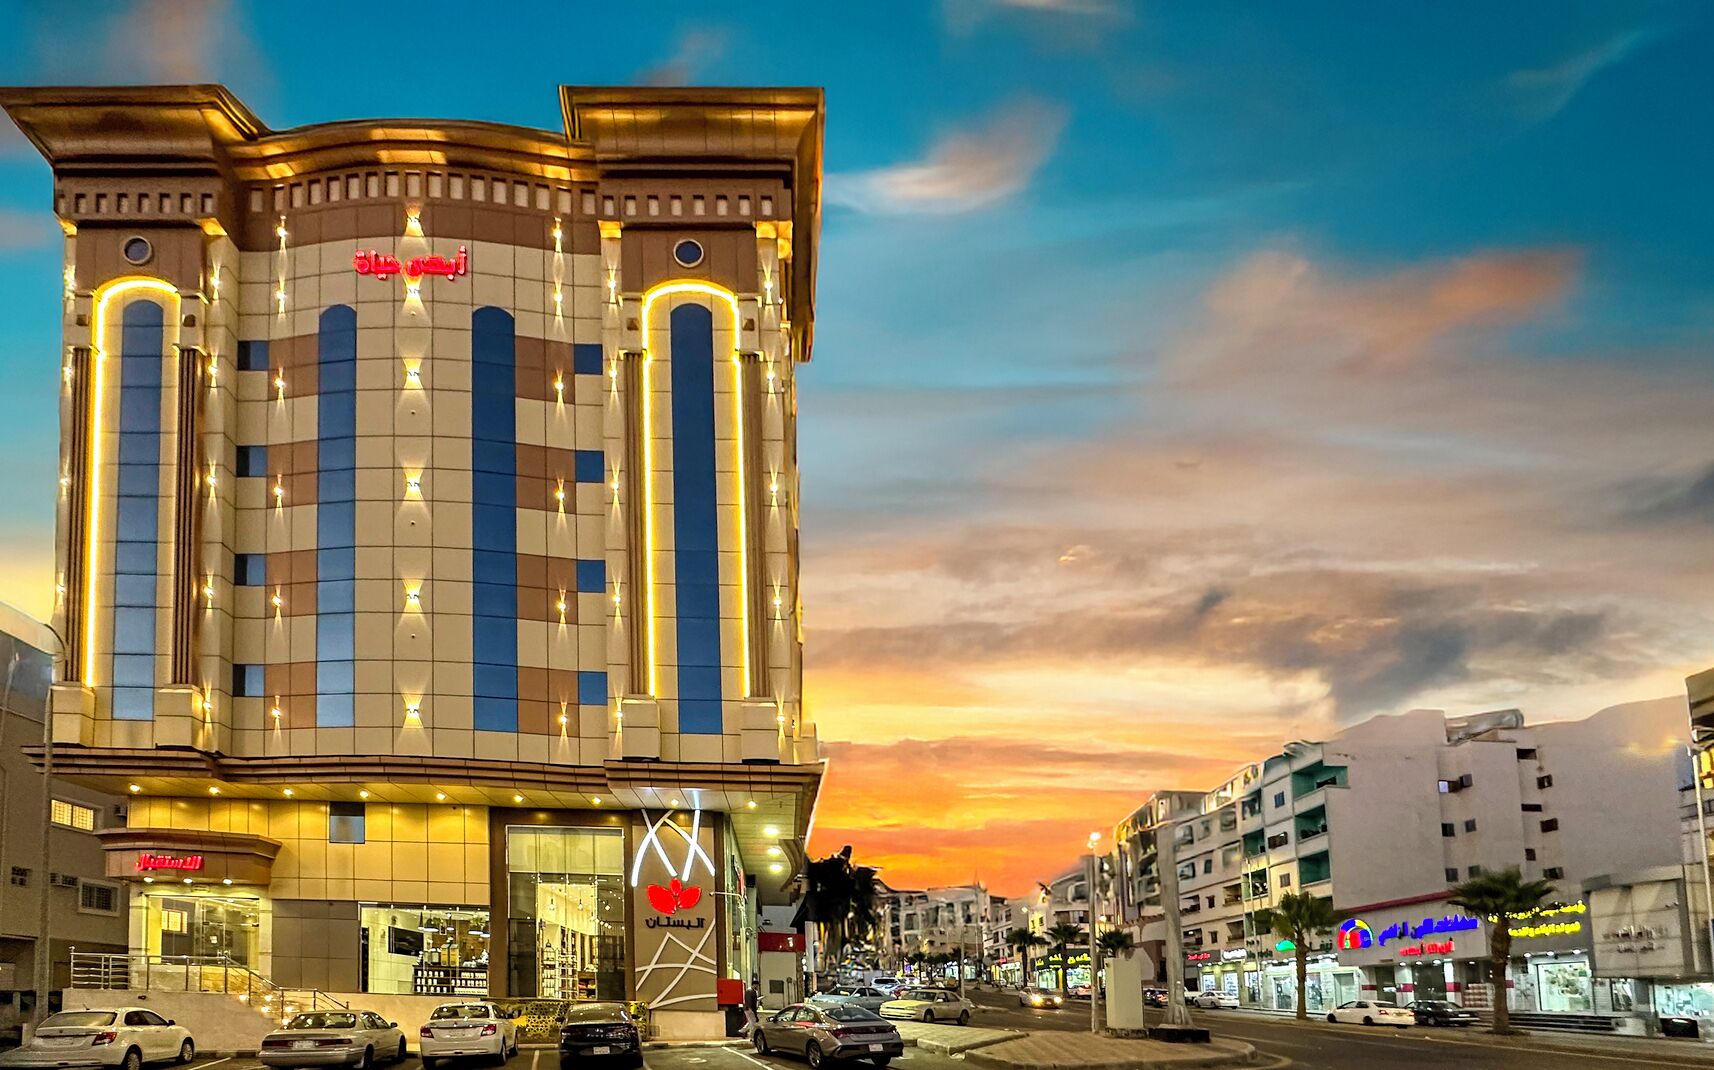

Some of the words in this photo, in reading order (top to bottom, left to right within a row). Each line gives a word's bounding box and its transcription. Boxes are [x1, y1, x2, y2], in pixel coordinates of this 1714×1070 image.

[352, 249, 402, 280] حياة
[134, 853, 202, 873] الاستقبال
[645, 916, 706, 930] البستان
